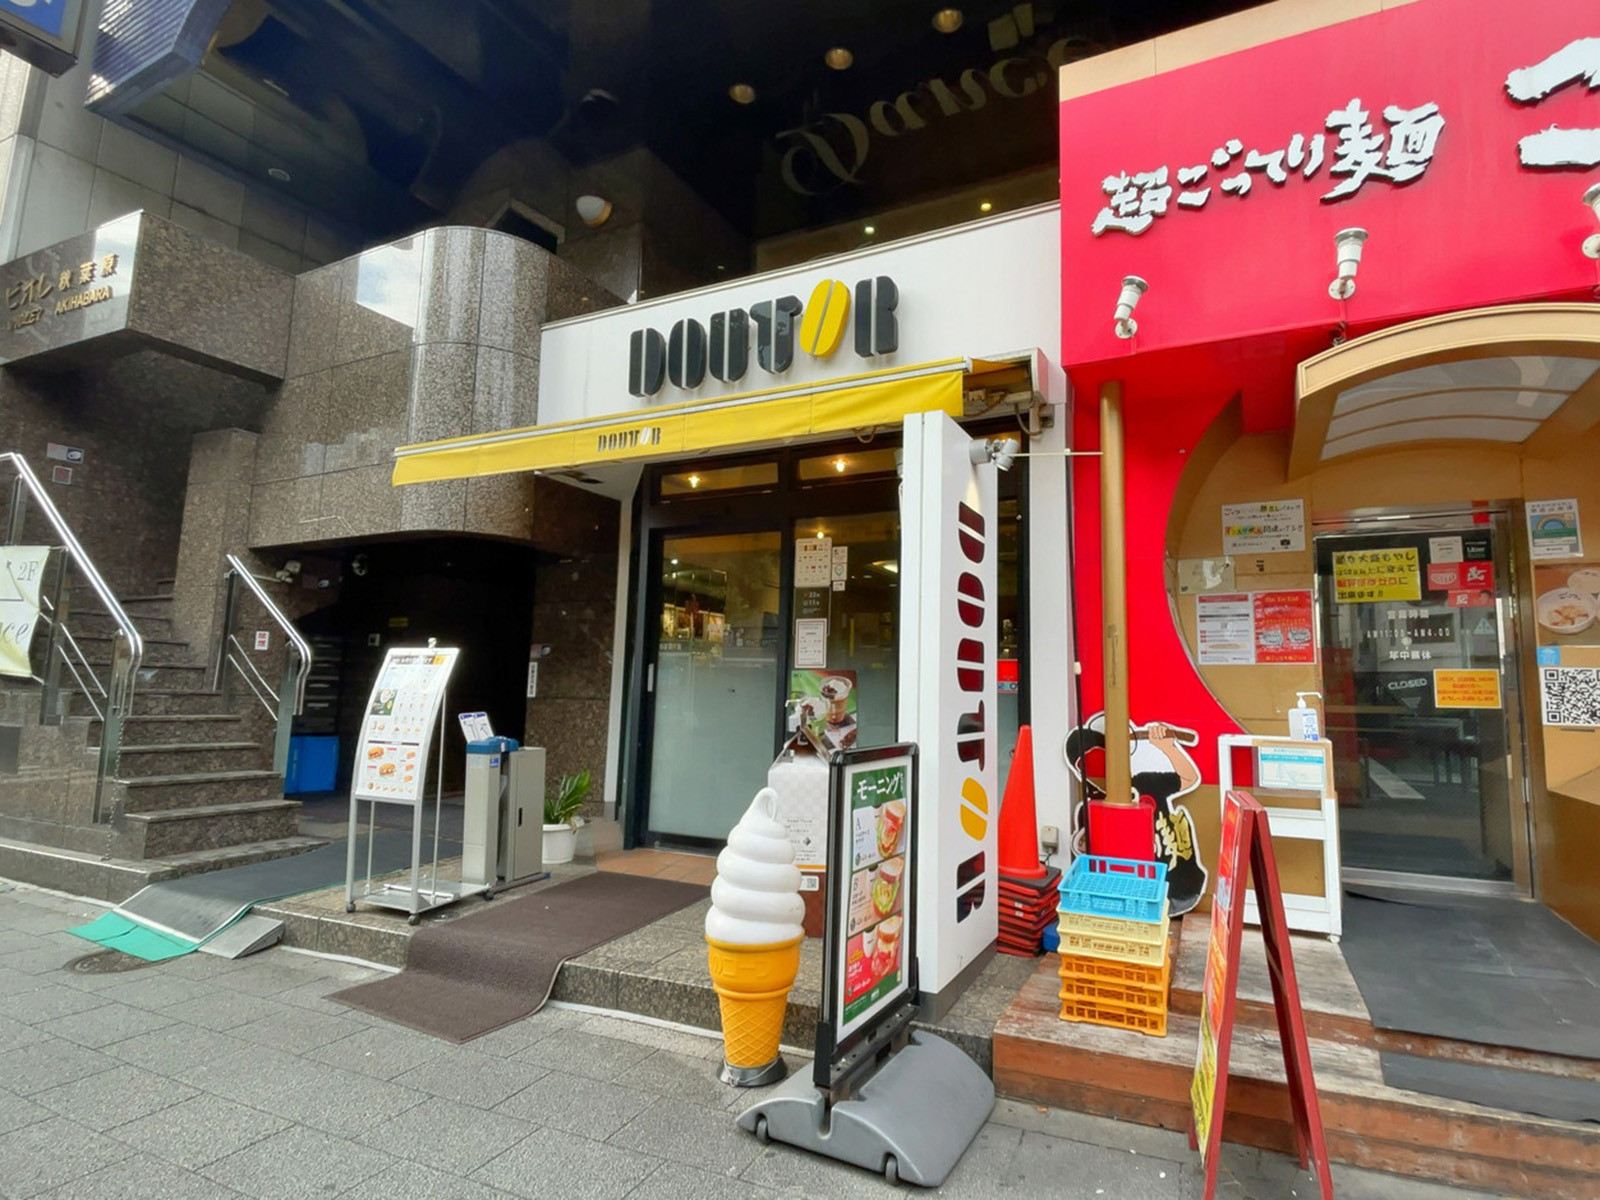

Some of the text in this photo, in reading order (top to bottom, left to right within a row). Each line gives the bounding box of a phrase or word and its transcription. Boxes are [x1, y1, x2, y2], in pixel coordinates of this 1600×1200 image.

[54, 285, 112, 316] AKIHABARA
[628, 275, 899, 398] DOUTOR
[598, 427, 661, 452] DOUTOR
[17, 560, 39, 582] 2F
[0, 620, 29, 645] ce
[1389, 650, 1431, 660] 年中無休
[1387, 678, 1428, 691] CLOSED
[957, 501, 988, 924] DOUTOR
[857, 771, 901, 800] モーニング
